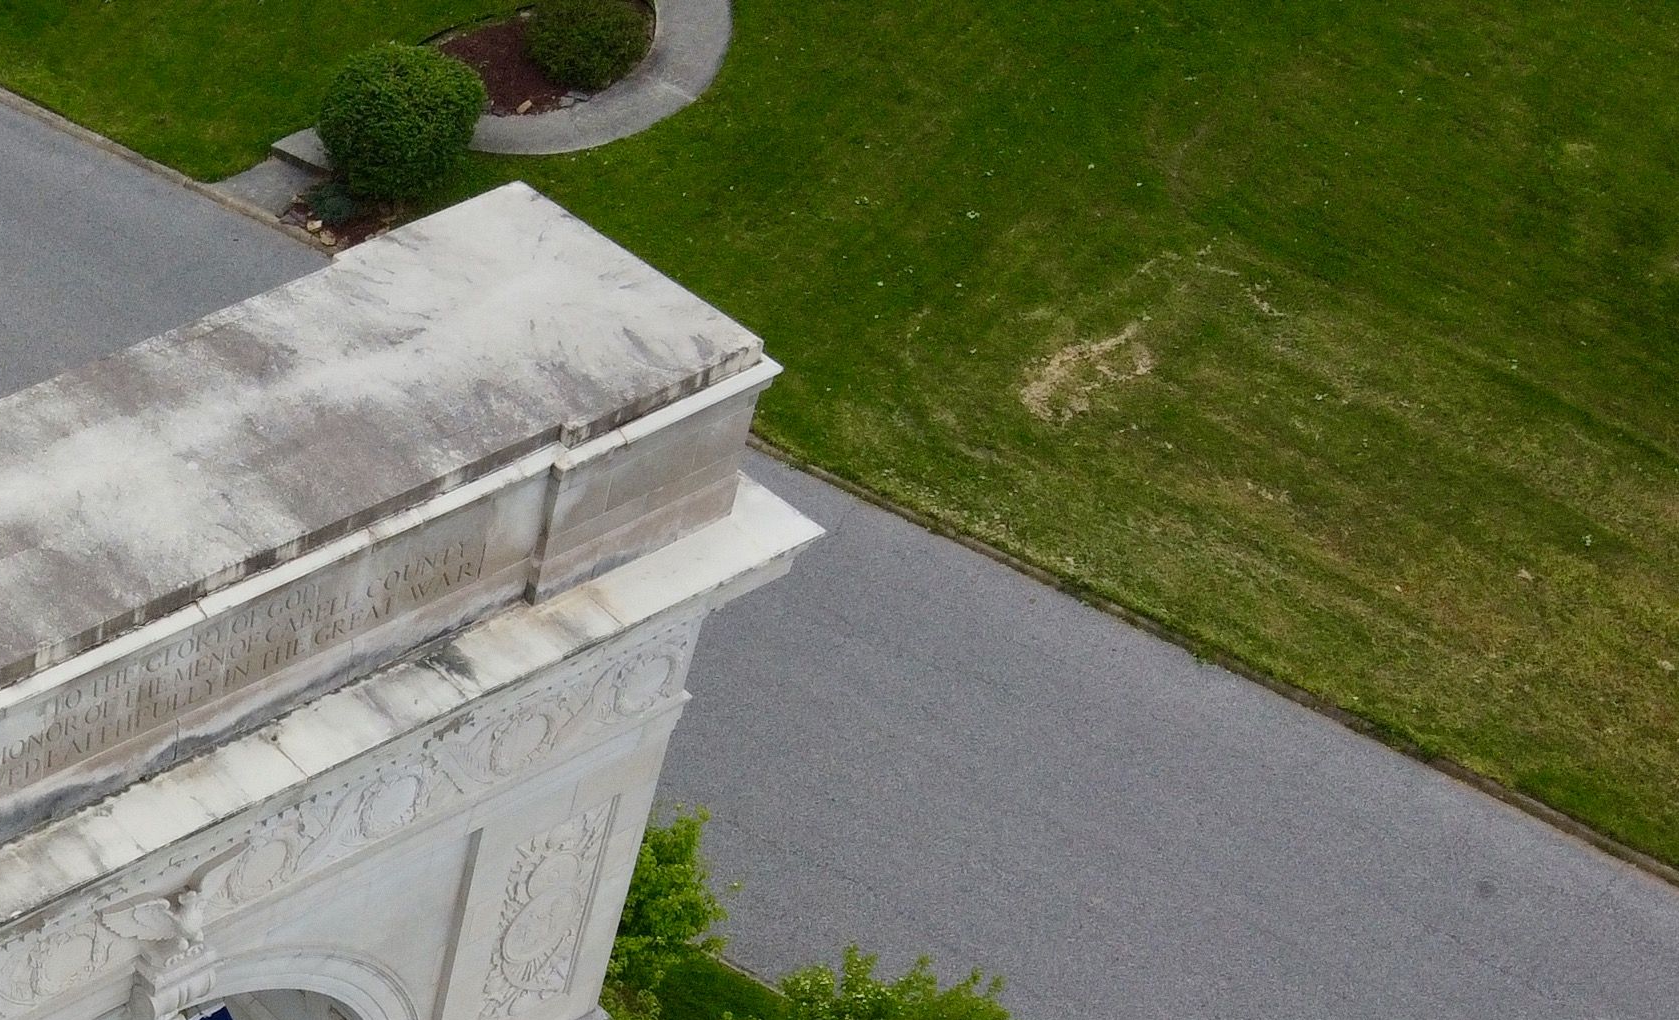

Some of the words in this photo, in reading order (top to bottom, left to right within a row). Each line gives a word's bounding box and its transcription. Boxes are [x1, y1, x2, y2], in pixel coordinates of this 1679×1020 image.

[47, 679, 214, 768] FAITHFULLY
[223, 659, 251, 687] IN
[261, 637, 307, 671] THE
[314, 596, 396, 646] GREAT
[410, 561, 472, 601] WAR
[51, 689, 82, 716] TO
[90, 665, 134, 698] THE
[145, 626, 224, 673] GLORY
[231, 609, 259, 634] OF
[267, 583, 317, 619] GOD
[84, 700, 113, 725] OF
[122, 676, 165, 708] THE
[173, 651, 226, 687] MEN
[229, 632, 260, 659] OF
[265, 591, 354, 643] CABELL
[366, 540, 466, 598] COUNTY
